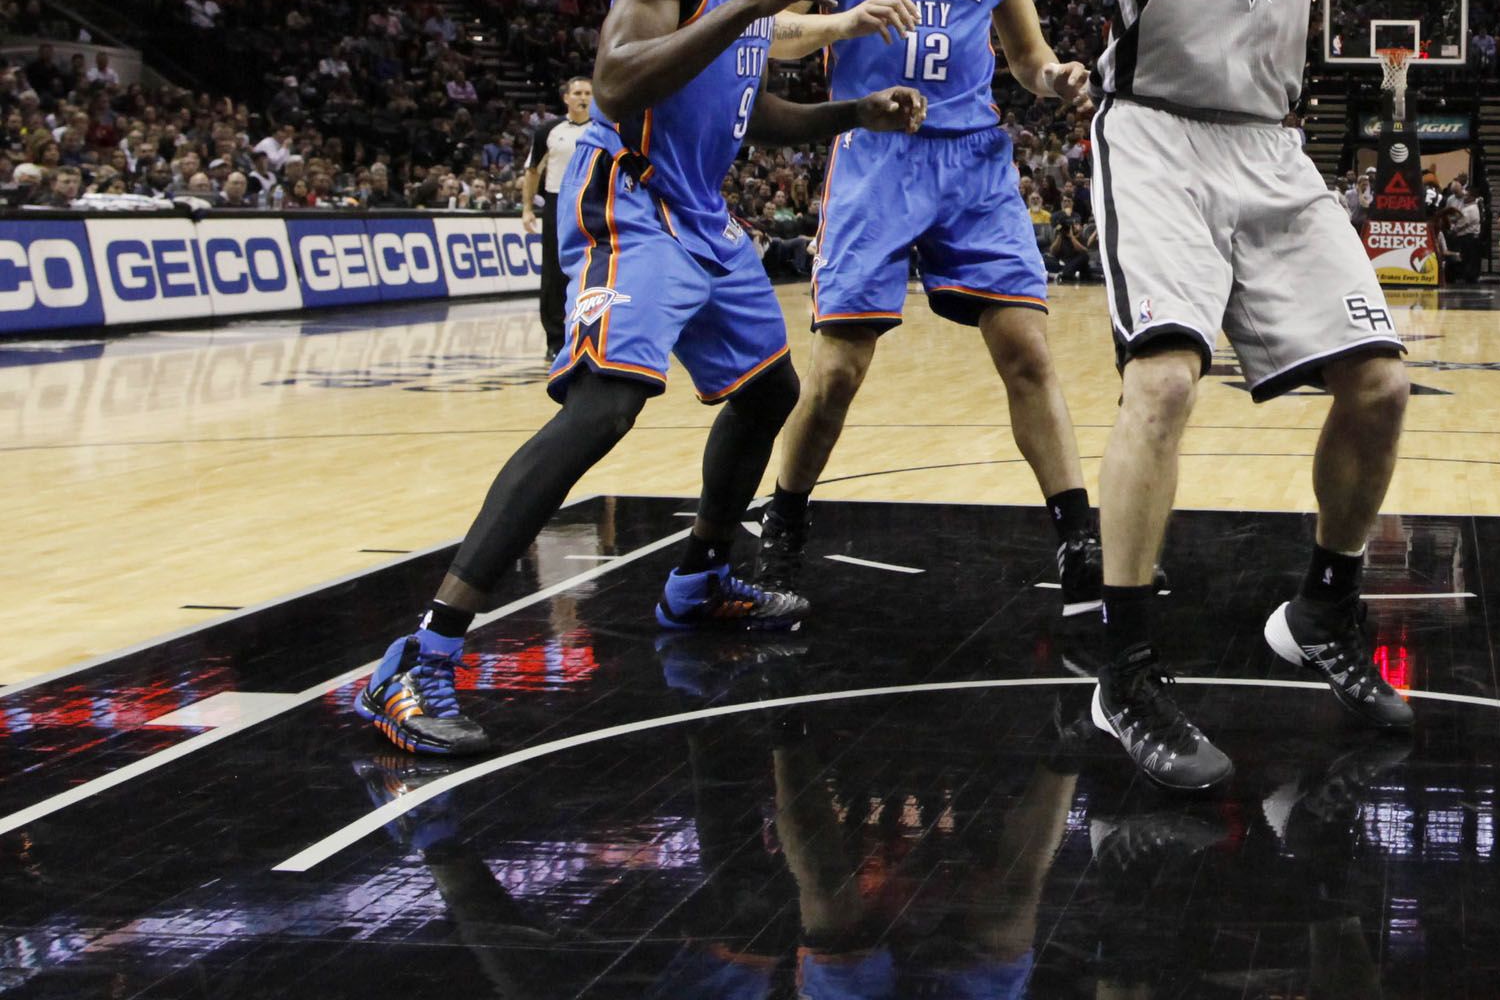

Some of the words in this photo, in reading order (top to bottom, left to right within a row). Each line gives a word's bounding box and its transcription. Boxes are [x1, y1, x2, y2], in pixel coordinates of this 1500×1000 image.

[914, 1, 951, 28] ITY
[736, 47, 767, 77] CITY
[904, 30, 950, 81] 12
[732, 87, 755, 139] 9
[1367, 235, 1428, 249] CHECK
[1369, 221, 1428, 235] BRAKE
[107, 237, 288, 302] GEICO
[299, 232, 439, 291] GEICO
[1346, 298, 1392, 332] SA
